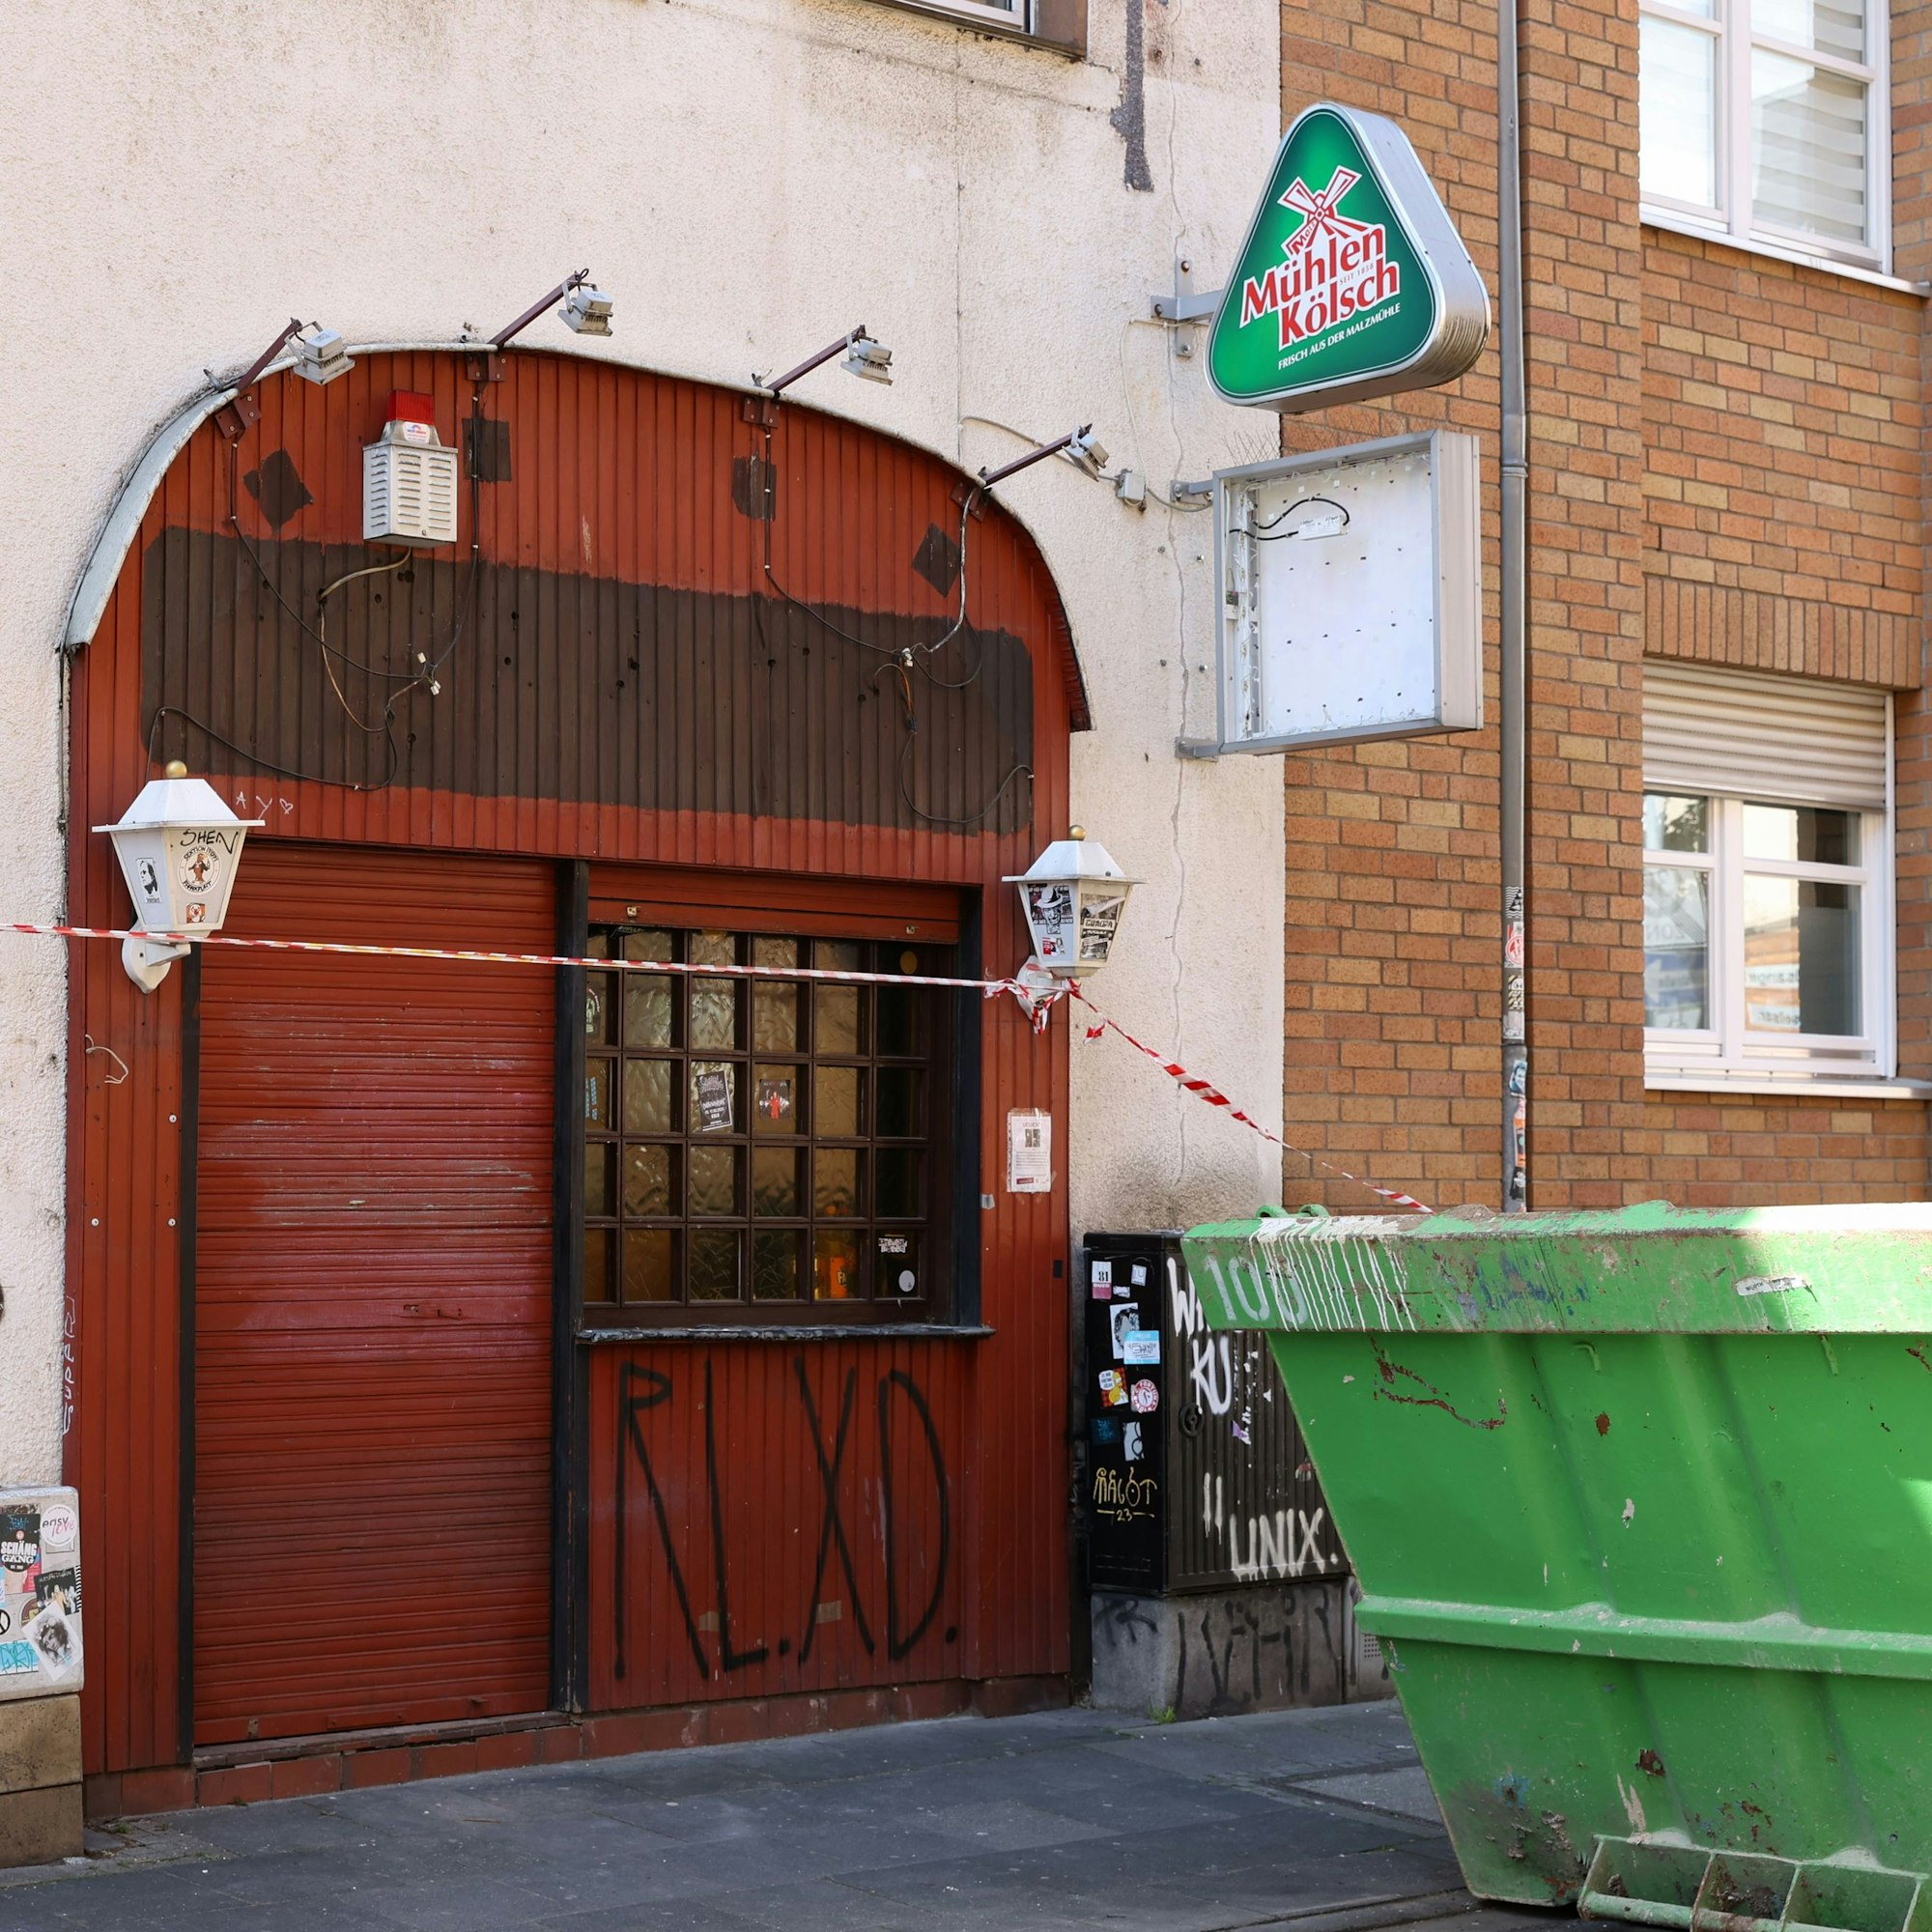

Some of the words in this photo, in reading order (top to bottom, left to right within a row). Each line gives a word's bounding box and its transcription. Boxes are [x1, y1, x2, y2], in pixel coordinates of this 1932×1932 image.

[1242, 227, 1383, 322] Mühlen
[1339, 272, 1354, 285] SEIT
[1281, 257, 1398, 347] Kölsch
[1278, 348, 1308, 370] FRISCH
[1309, 340, 1326, 356] AUS
[1327, 330, 1346, 347] DER
[1346, 302, 1401, 338] MALZMÜHLE
[1098, 1271, 1110, 1282] 81
[1, 1540, 37, 1556] SCHÄNG
